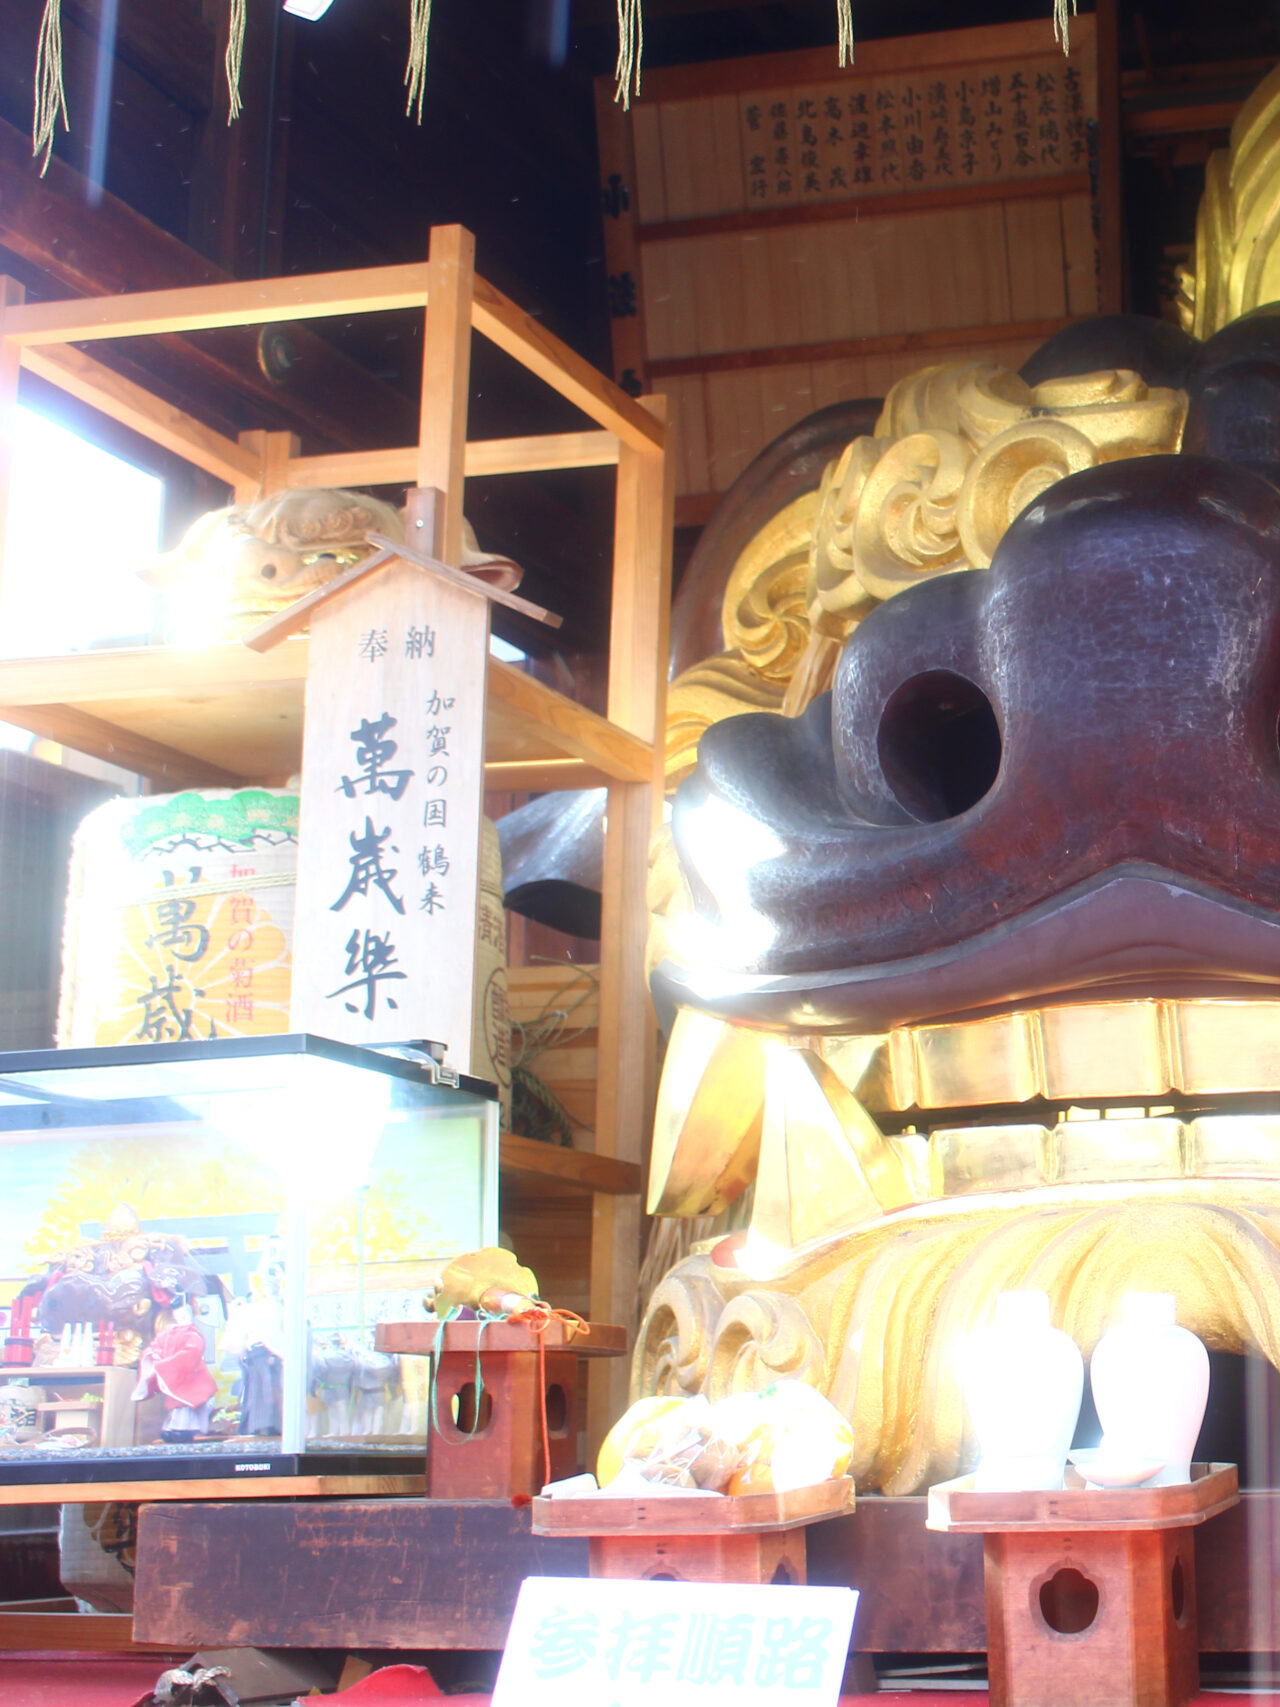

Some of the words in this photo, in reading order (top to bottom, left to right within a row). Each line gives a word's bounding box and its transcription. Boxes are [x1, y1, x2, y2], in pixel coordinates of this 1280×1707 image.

[359, 625, 436, 663] 奉納
[234, 1463, 271, 1471] KOTOBUKI
[529, 1606, 834, 1690] 参拝順路
